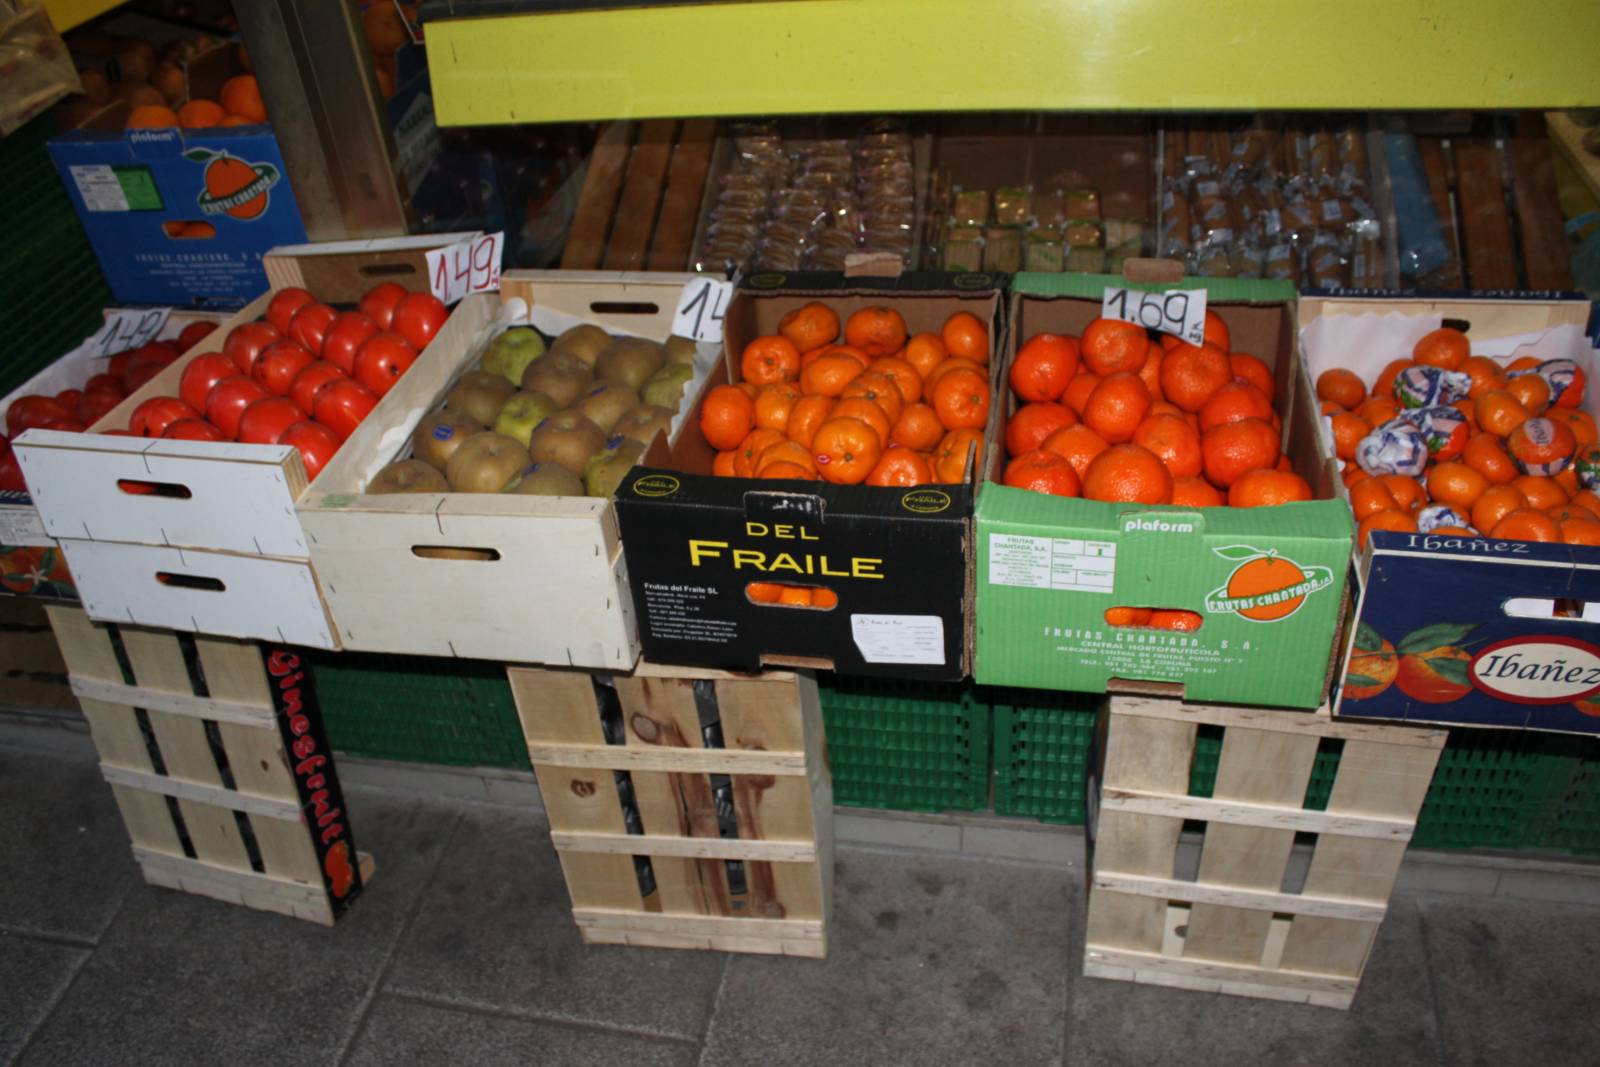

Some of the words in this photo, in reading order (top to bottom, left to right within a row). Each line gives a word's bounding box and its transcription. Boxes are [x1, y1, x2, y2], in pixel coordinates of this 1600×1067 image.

[746, 522, 819, 541] DEL
[1125, 519, 1193, 533] plaform
[1407, 534, 1531, 553] Ibañez
[689, 540, 885, 580] FRAILE
[644, 583, 669, 591] Frutas
[670, 585, 683, 593] del
[684, 586, 706, 594] Fraile
[1209, 597, 1254, 611] FRUTAS
[1257, 579, 1319, 607] CHANTADA
[1044, 627, 1103, 641] FRUTAS
[1081, 641, 1124, 651] CENTRAL
[1479, 653, 1600, 685] Ibañez
[266, 650, 344, 845] Ginesfruit
